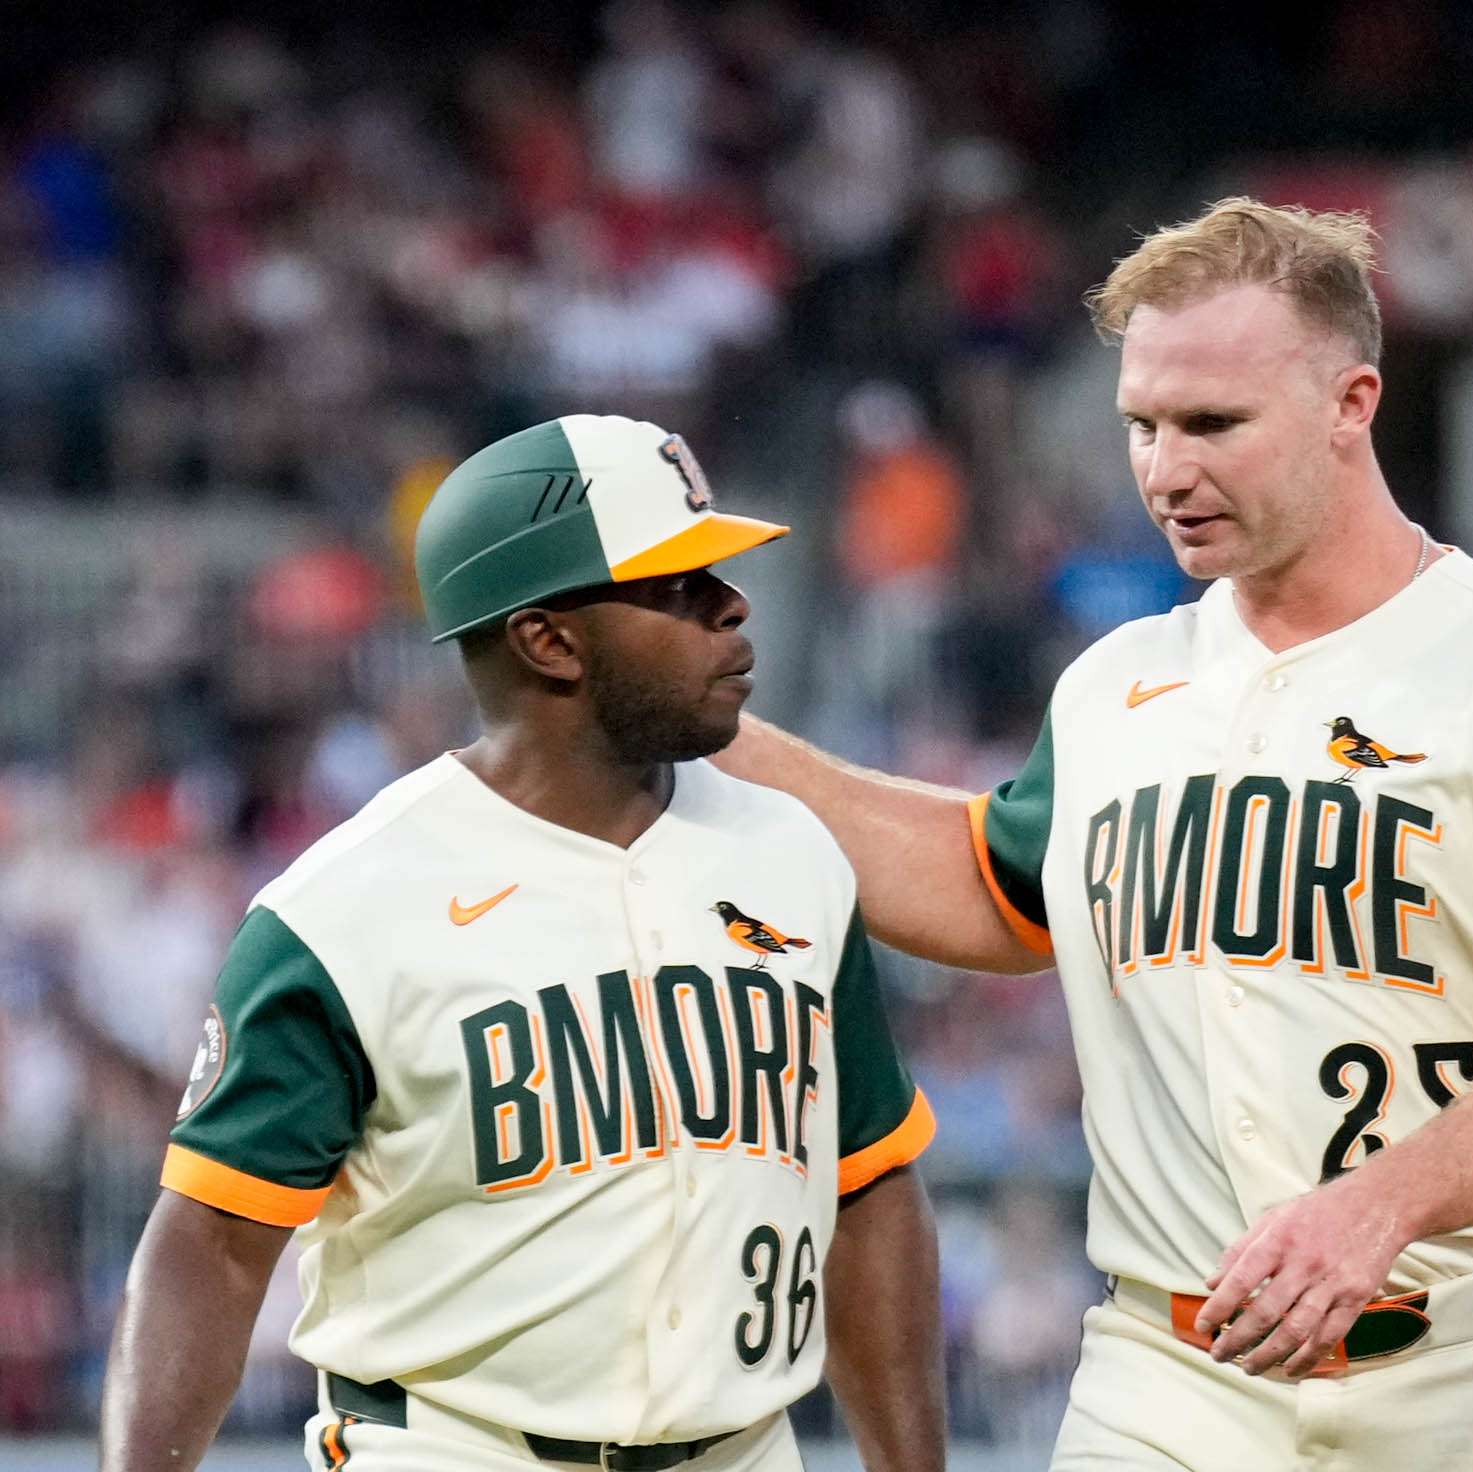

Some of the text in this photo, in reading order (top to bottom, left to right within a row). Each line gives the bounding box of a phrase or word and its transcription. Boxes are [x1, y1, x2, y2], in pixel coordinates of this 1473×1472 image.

[1084, 773, 1444, 1000] BMORE
[460, 965, 830, 1193] BMORE
[735, 1225, 817, 1368] 36
